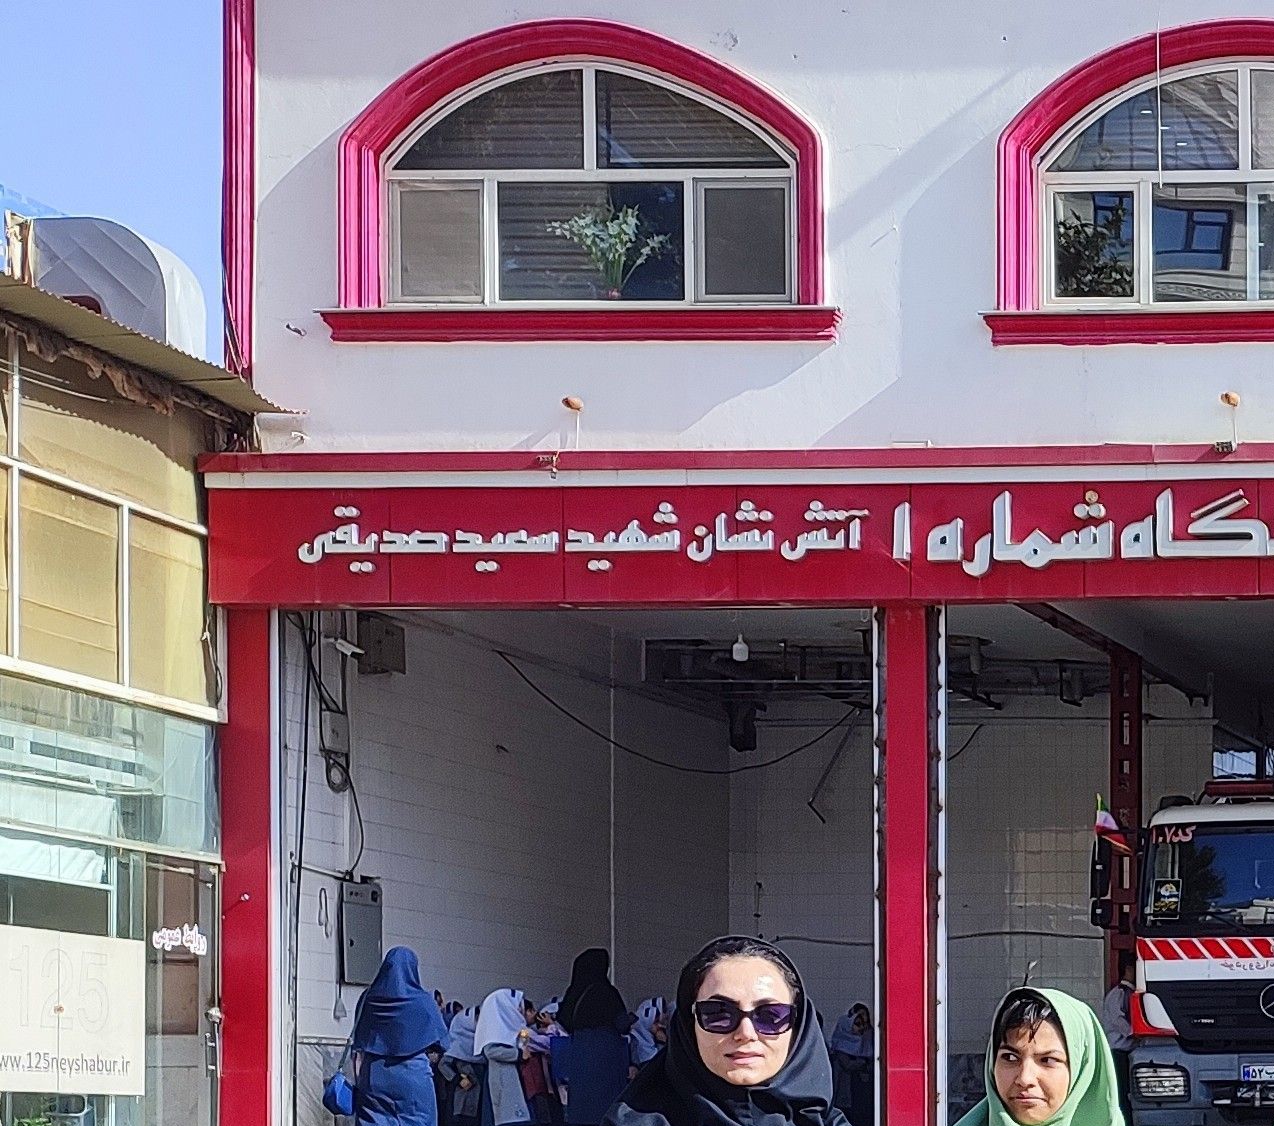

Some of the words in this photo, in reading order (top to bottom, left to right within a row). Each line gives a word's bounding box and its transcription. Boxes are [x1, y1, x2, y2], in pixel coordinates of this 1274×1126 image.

[297, 505, 450, 574] صدیقی
[453, 529, 560, 573] سعید
[564, 501, 681, 573] شهید
[686, 499, 775, 562] نشان
[780, 499, 870, 561] آتش
[926, 489, 1114, 577] شماره
[10, 944, 109, 1033] 125
